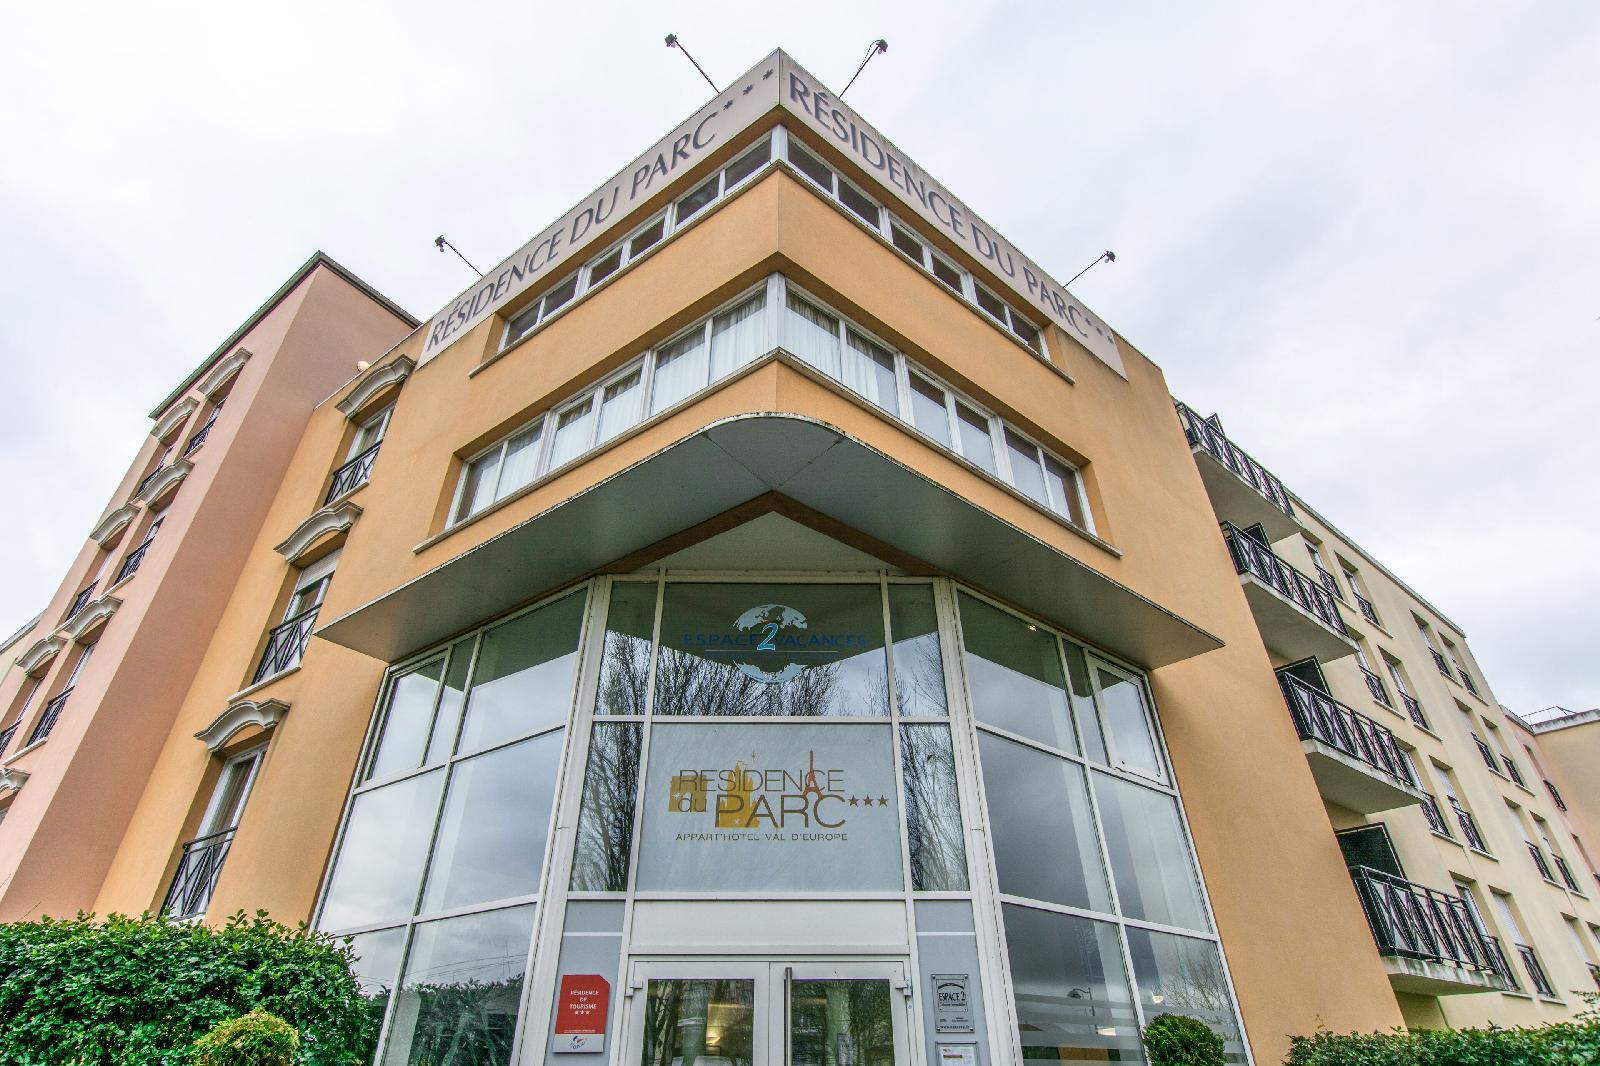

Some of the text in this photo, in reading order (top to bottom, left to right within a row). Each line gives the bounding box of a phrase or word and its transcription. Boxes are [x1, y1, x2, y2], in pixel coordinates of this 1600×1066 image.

[788, 72, 1089, 338] RÉSIDENCE DU PARC
[427, 111, 718, 352] RÉSIDENCE DU PARC
[681, 622, 867, 651] ESPACE 2 VACANCES
[679, 769, 845, 792] RESIDENCE
[677, 792, 846, 829] du PARC
[765, 833, 786, 841] VAL
[791, 833, 848, 841] D'EUROPE
